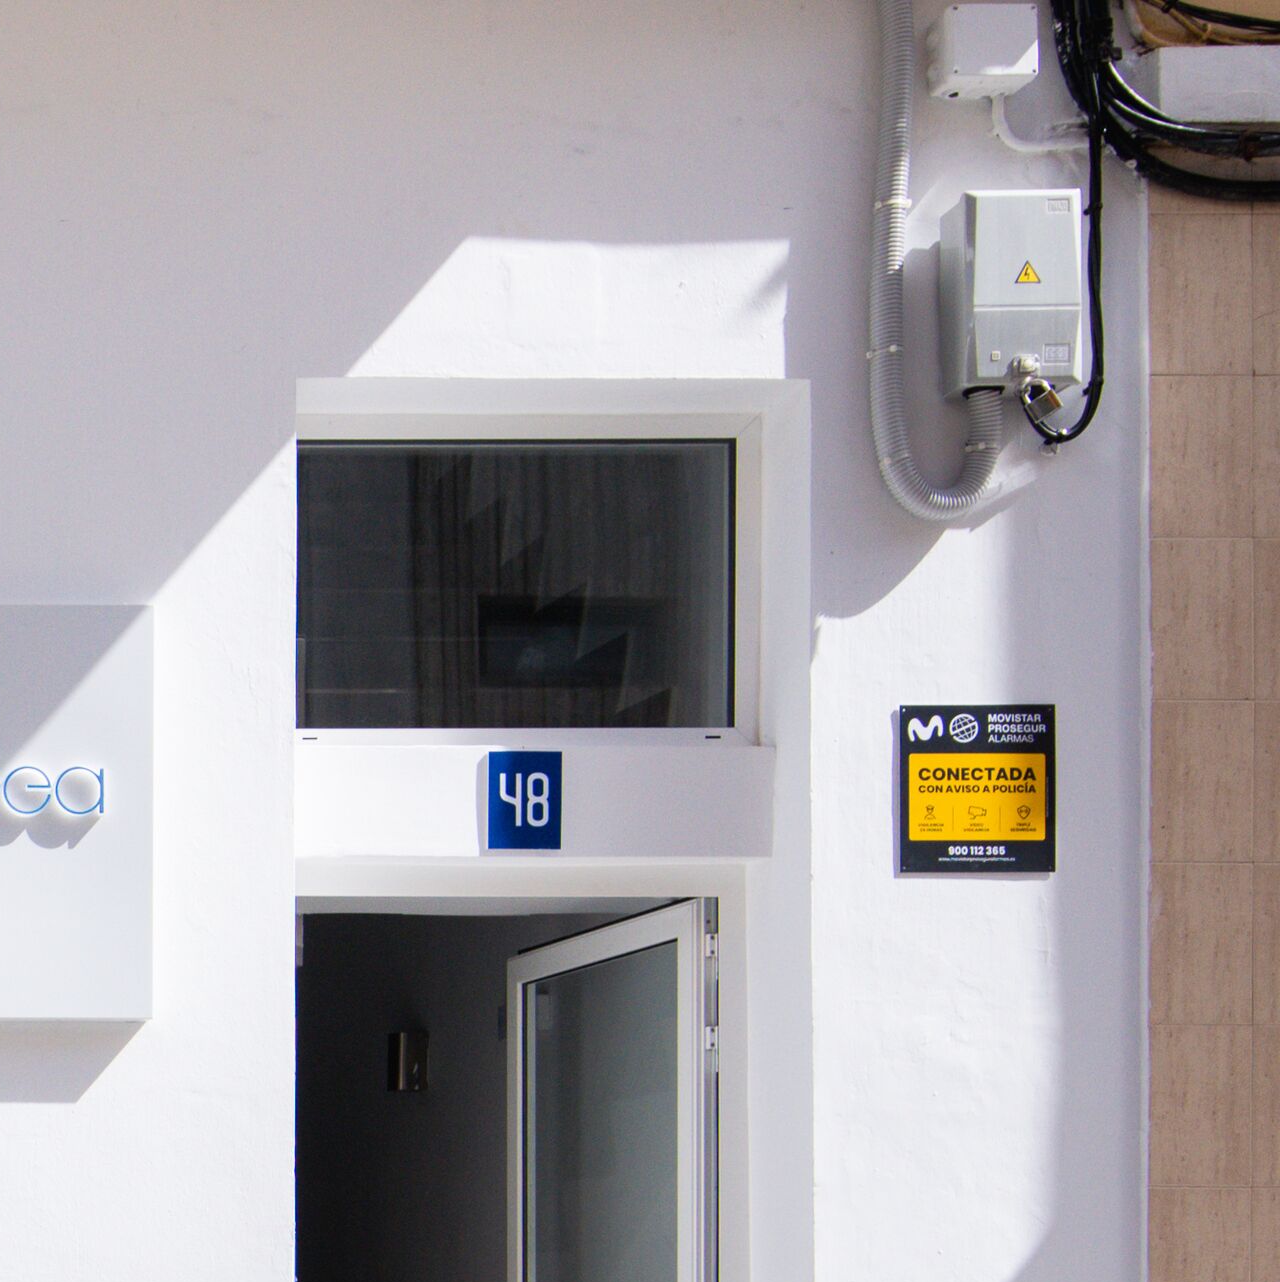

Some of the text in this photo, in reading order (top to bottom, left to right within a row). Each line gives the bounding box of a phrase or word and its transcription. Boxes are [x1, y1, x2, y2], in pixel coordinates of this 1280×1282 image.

[987, 713, 1042, 723] MOVISTAR
[987, 723, 1047, 733] PROSEGUR
[987, 734, 1035, 743] ALARMAS
[918, 767, 1037, 781] CONECTADA
[918, 782, 1037, 794] CON AVISO A POLICÍA
[499, 771, 549, 828] 48
[948, 845, 1006, 856] 900 112 365
